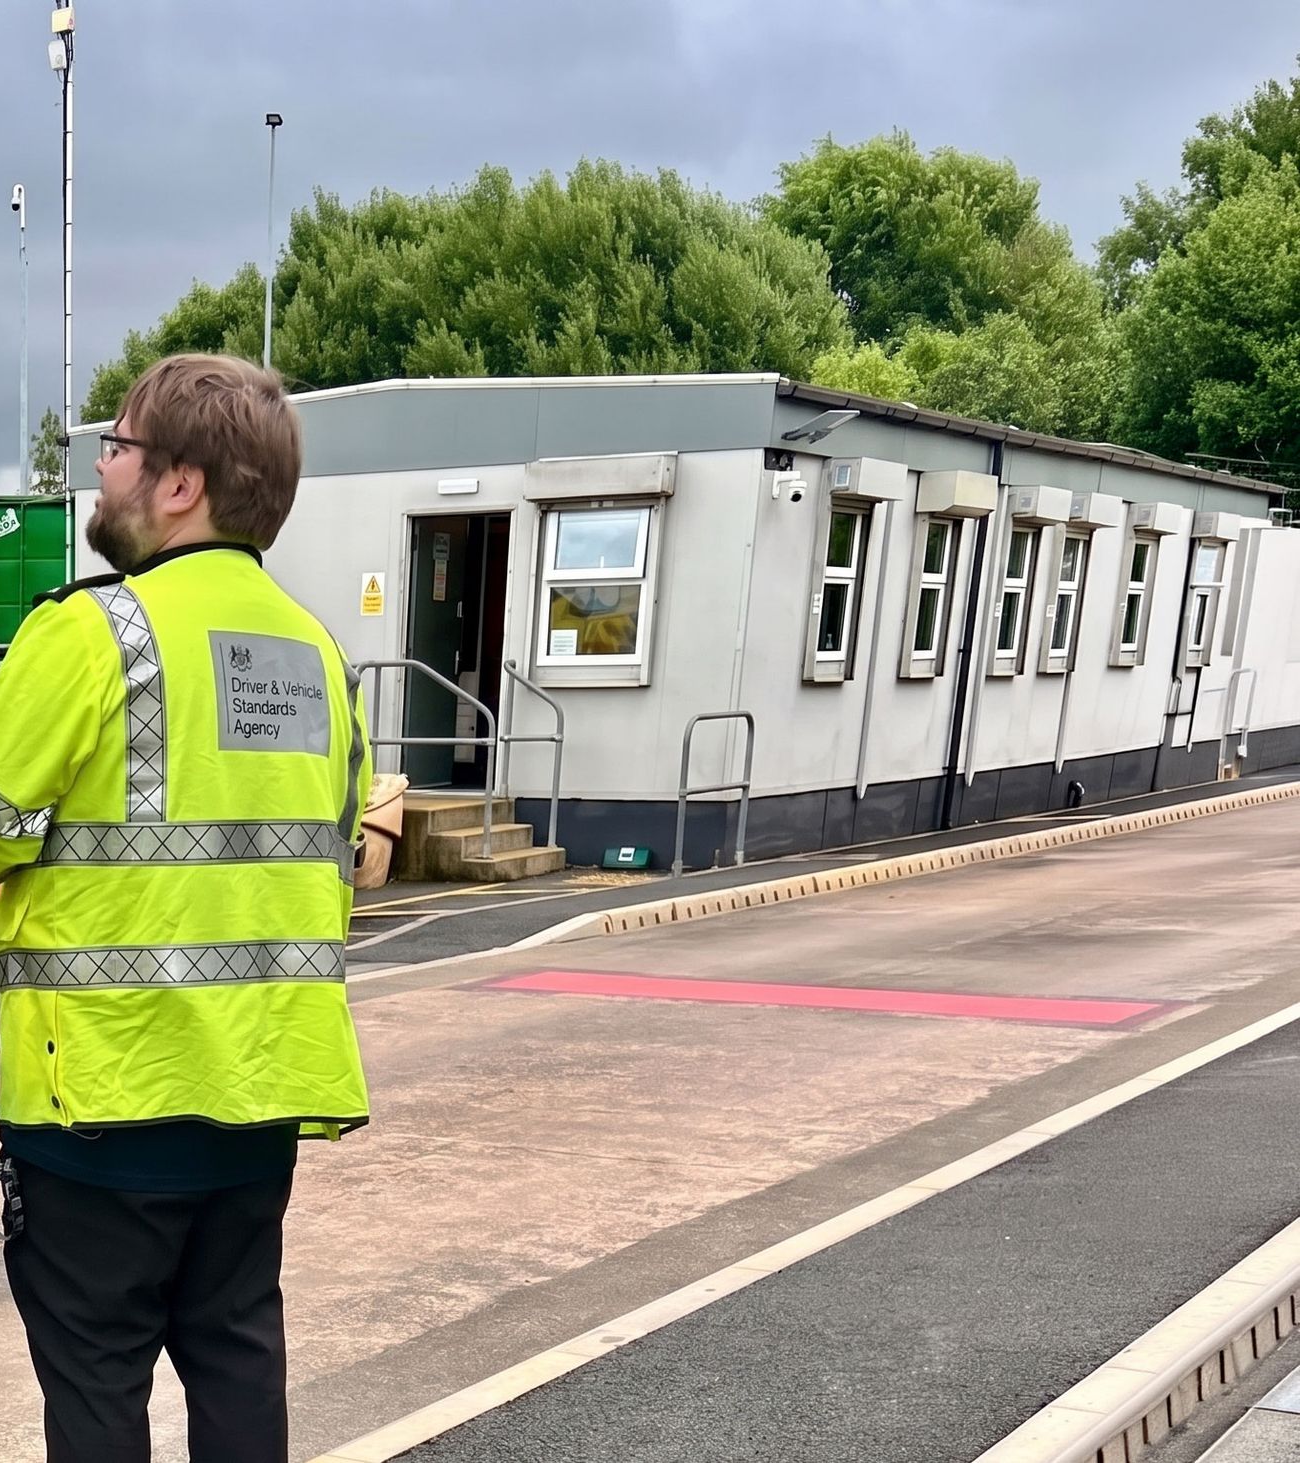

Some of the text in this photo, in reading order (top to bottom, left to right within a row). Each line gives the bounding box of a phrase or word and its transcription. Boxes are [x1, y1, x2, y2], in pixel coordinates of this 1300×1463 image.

[232, 678, 323, 700] Driver & Vehicle
[232, 697, 297, 716] Standards
[234, 719, 280, 739] Agency
